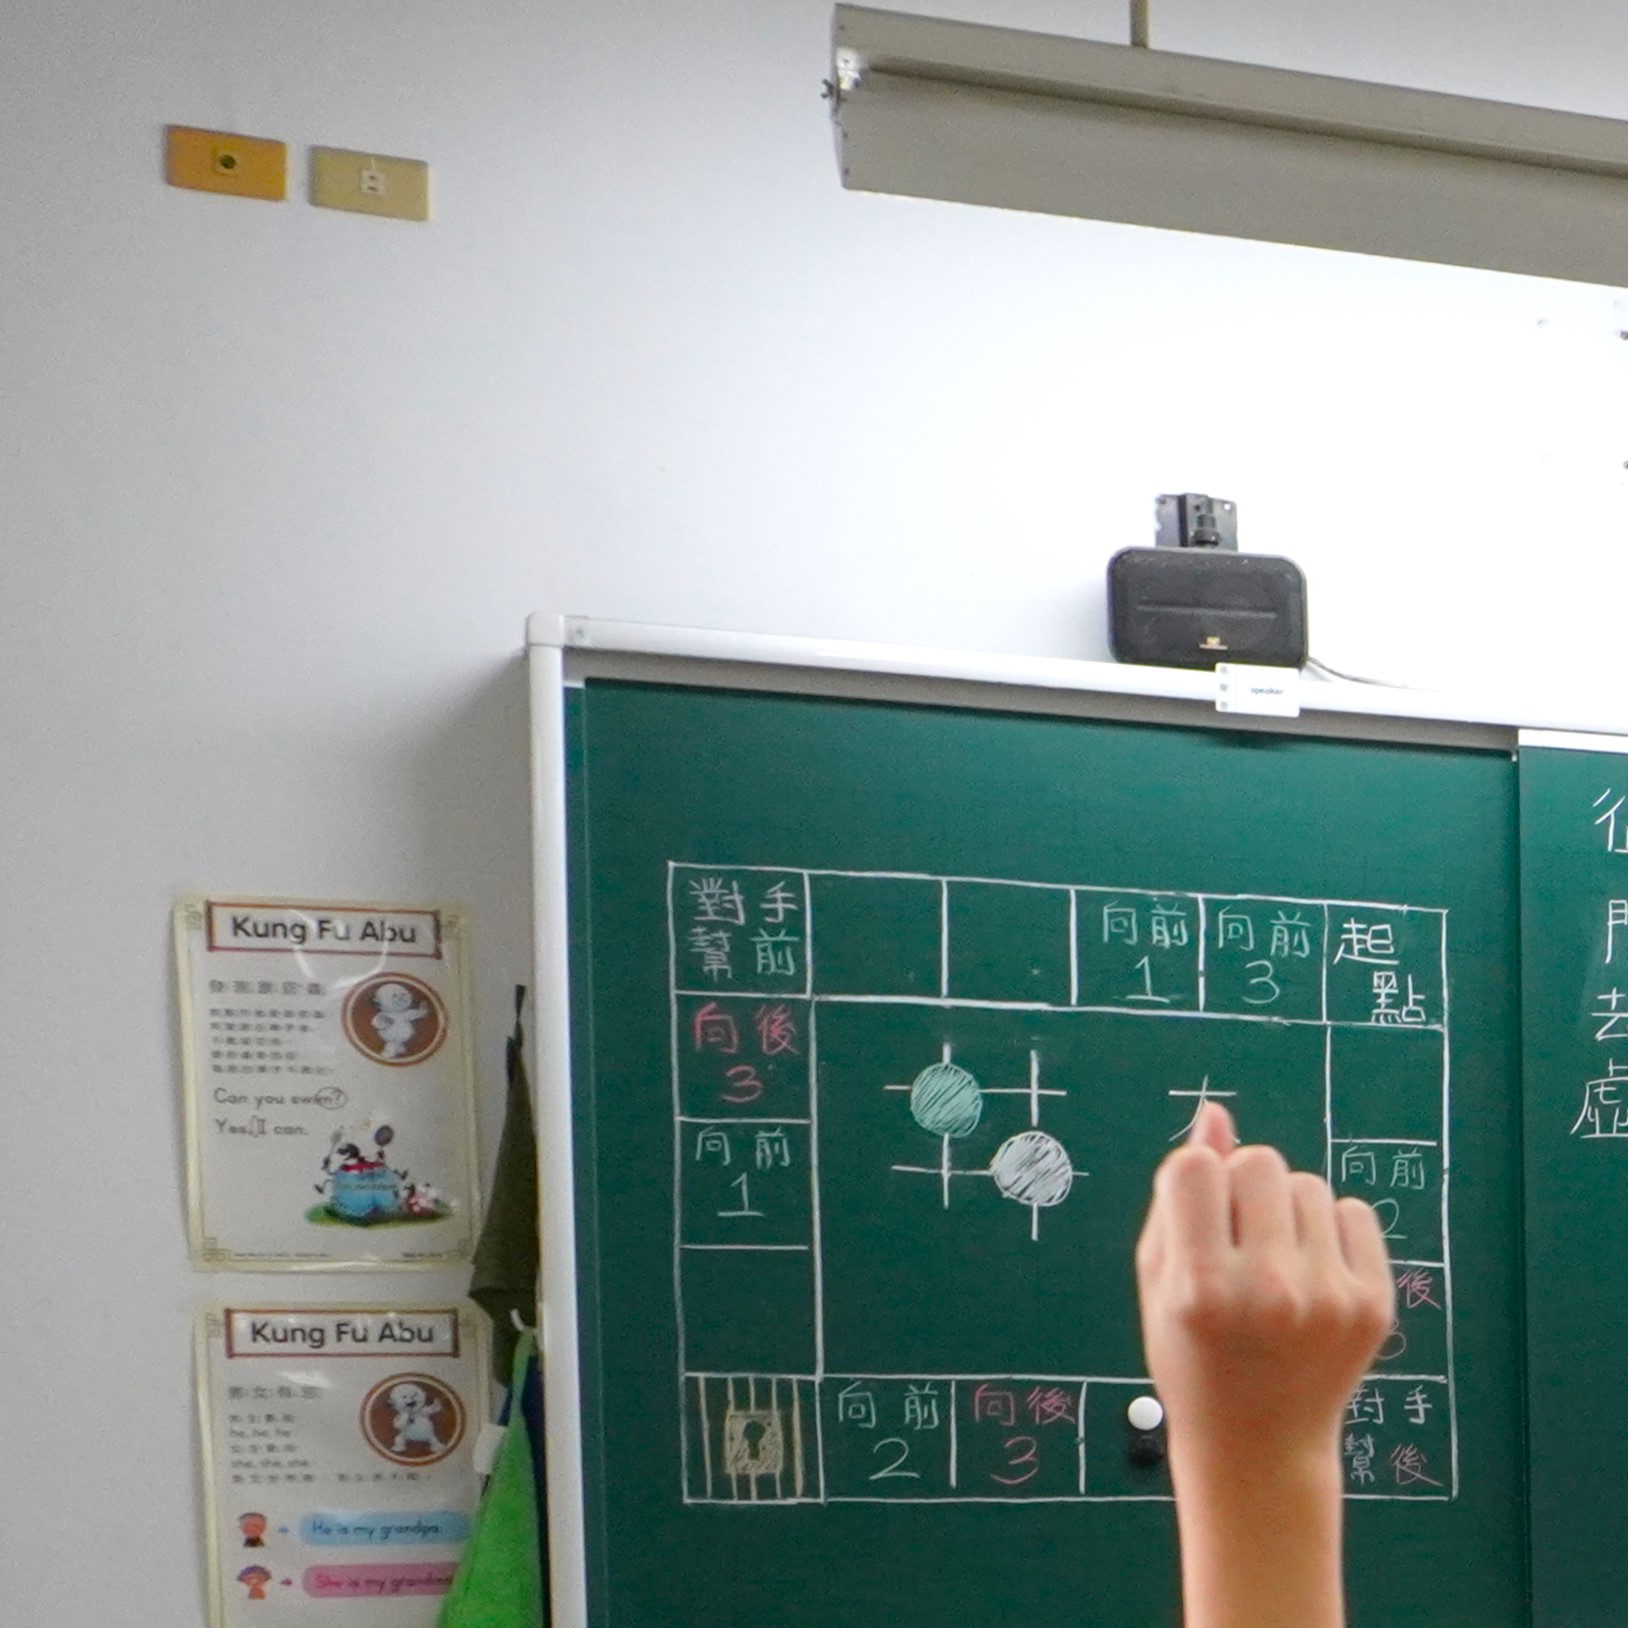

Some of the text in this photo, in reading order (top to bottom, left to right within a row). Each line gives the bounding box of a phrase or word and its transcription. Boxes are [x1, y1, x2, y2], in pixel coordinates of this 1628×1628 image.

[231, 916, 417, 944] Kung Fu Abu
[1103, 898, 1187, 949] 向前
[1219, 905, 1311, 958] 向前
[1126, 955, 1170, 1004] 1
[1242, 960, 1281, 1004] 3
[693, 1002, 799, 1055] 向後
[721, 1065, 763, 1103] 3
[695, 1126, 790, 1169] 向前
[1341, 1140, 1426, 1190] 向前
[718, 1173, 765, 1217] 1
[251, 1321, 434, 1348] Kung Fu Abu
[838, 1381, 940, 1430] 向前
[973, 1383, 1077, 1427] 向後
[869, 1438, 920, 1481] 2
[989, 1436, 1040, 1485] 3
